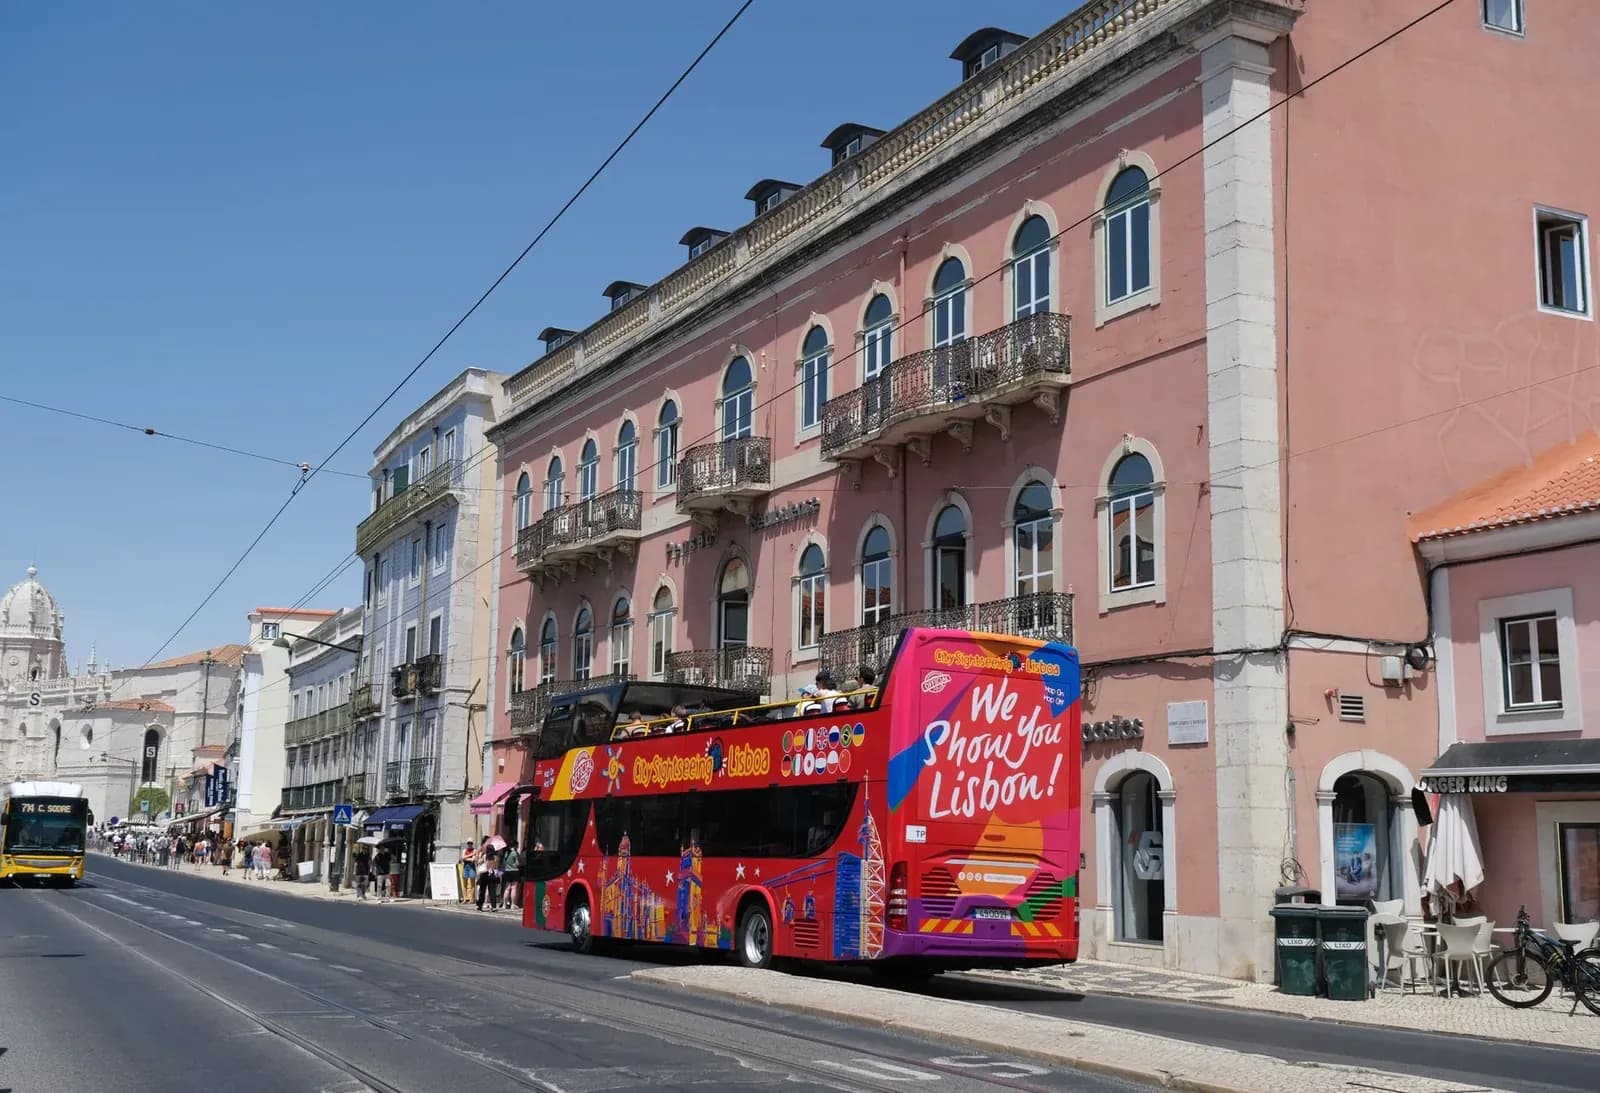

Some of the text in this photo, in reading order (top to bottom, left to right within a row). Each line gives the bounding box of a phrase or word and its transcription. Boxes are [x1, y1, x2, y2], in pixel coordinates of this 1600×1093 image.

[1026, 658, 1060, 675] Lisboa
[971, 675, 1018, 724] We
[923, 705, 1062, 769] Show You
[728, 742, 770, 777] Lisboa
[929, 753, 1063, 818] Lisbon!
[1468, 775, 1508, 792] KING
[915, 830, 926, 838] TP
